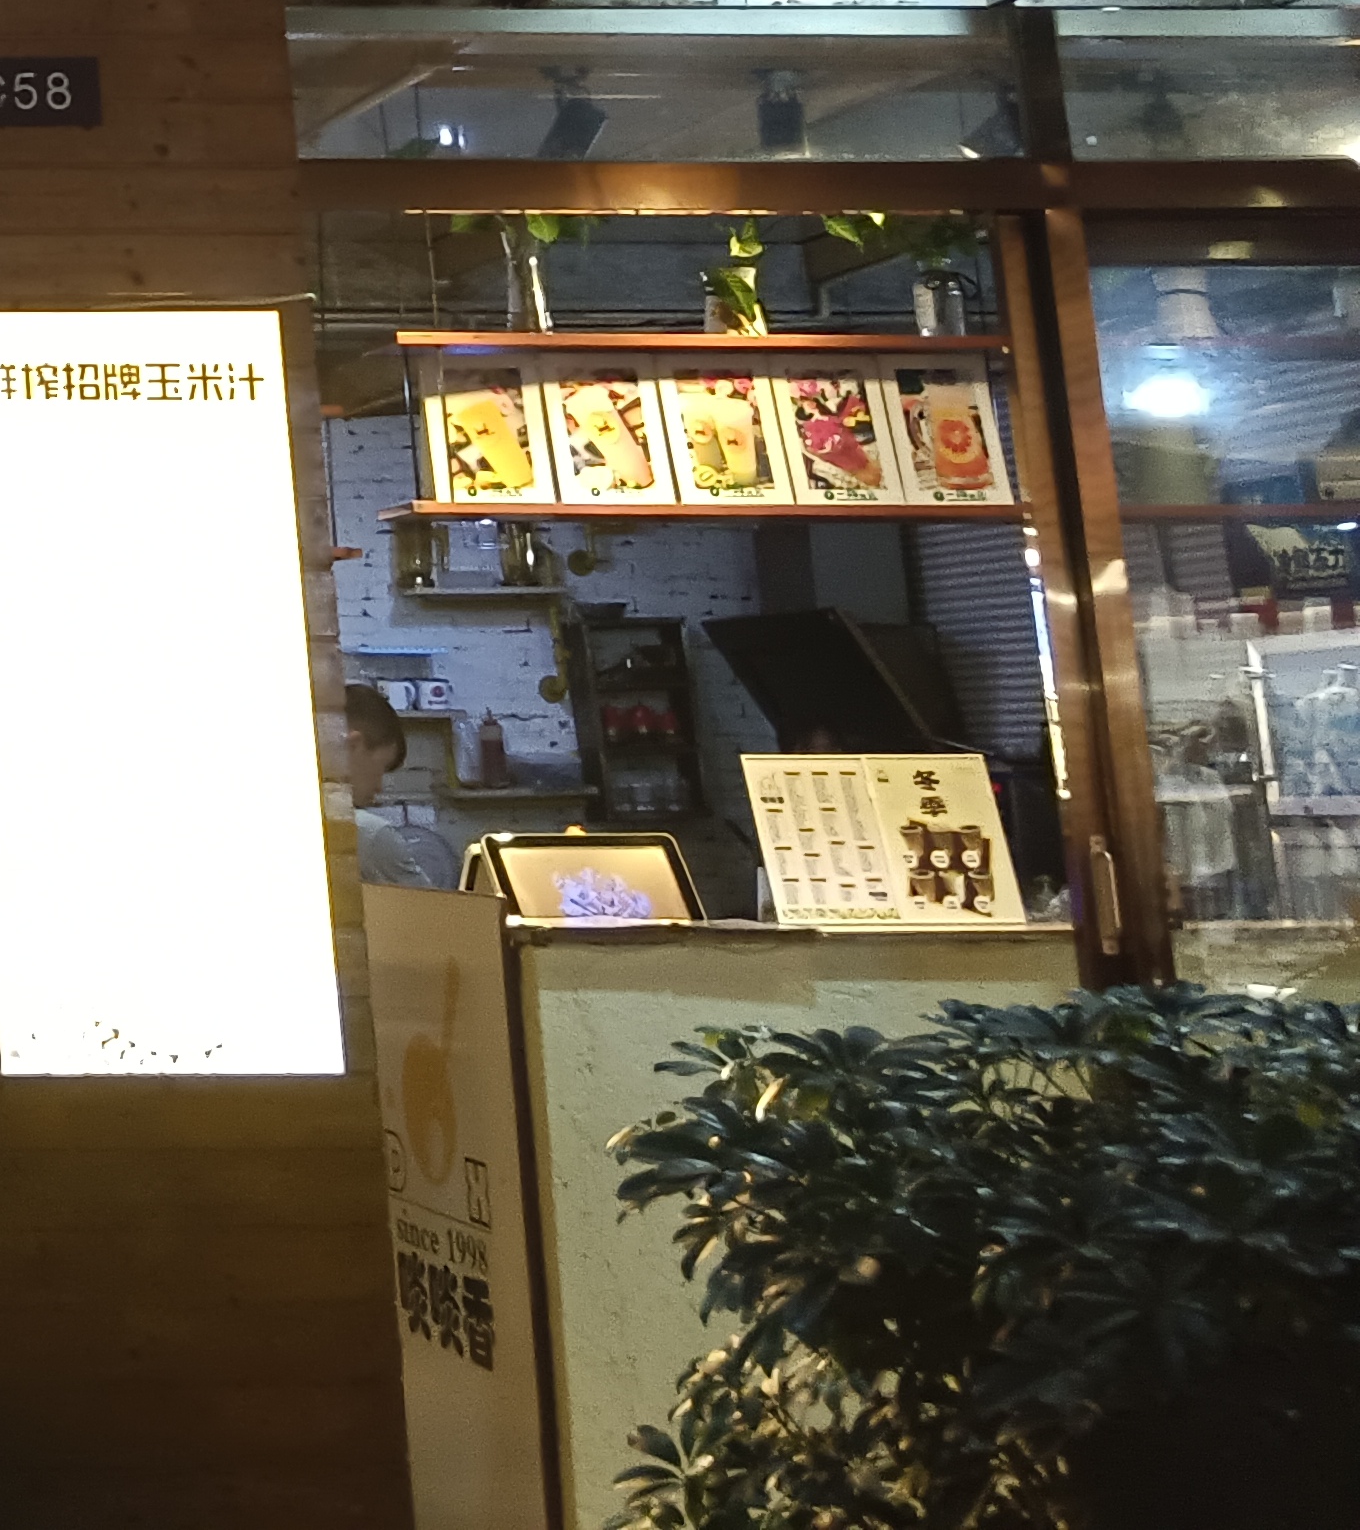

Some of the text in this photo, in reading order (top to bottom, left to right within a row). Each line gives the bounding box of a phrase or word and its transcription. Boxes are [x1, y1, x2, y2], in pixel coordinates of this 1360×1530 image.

[396, 1208, 489, 1274] since 1998
[397, 1250, 494, 1372] 啖啖香
